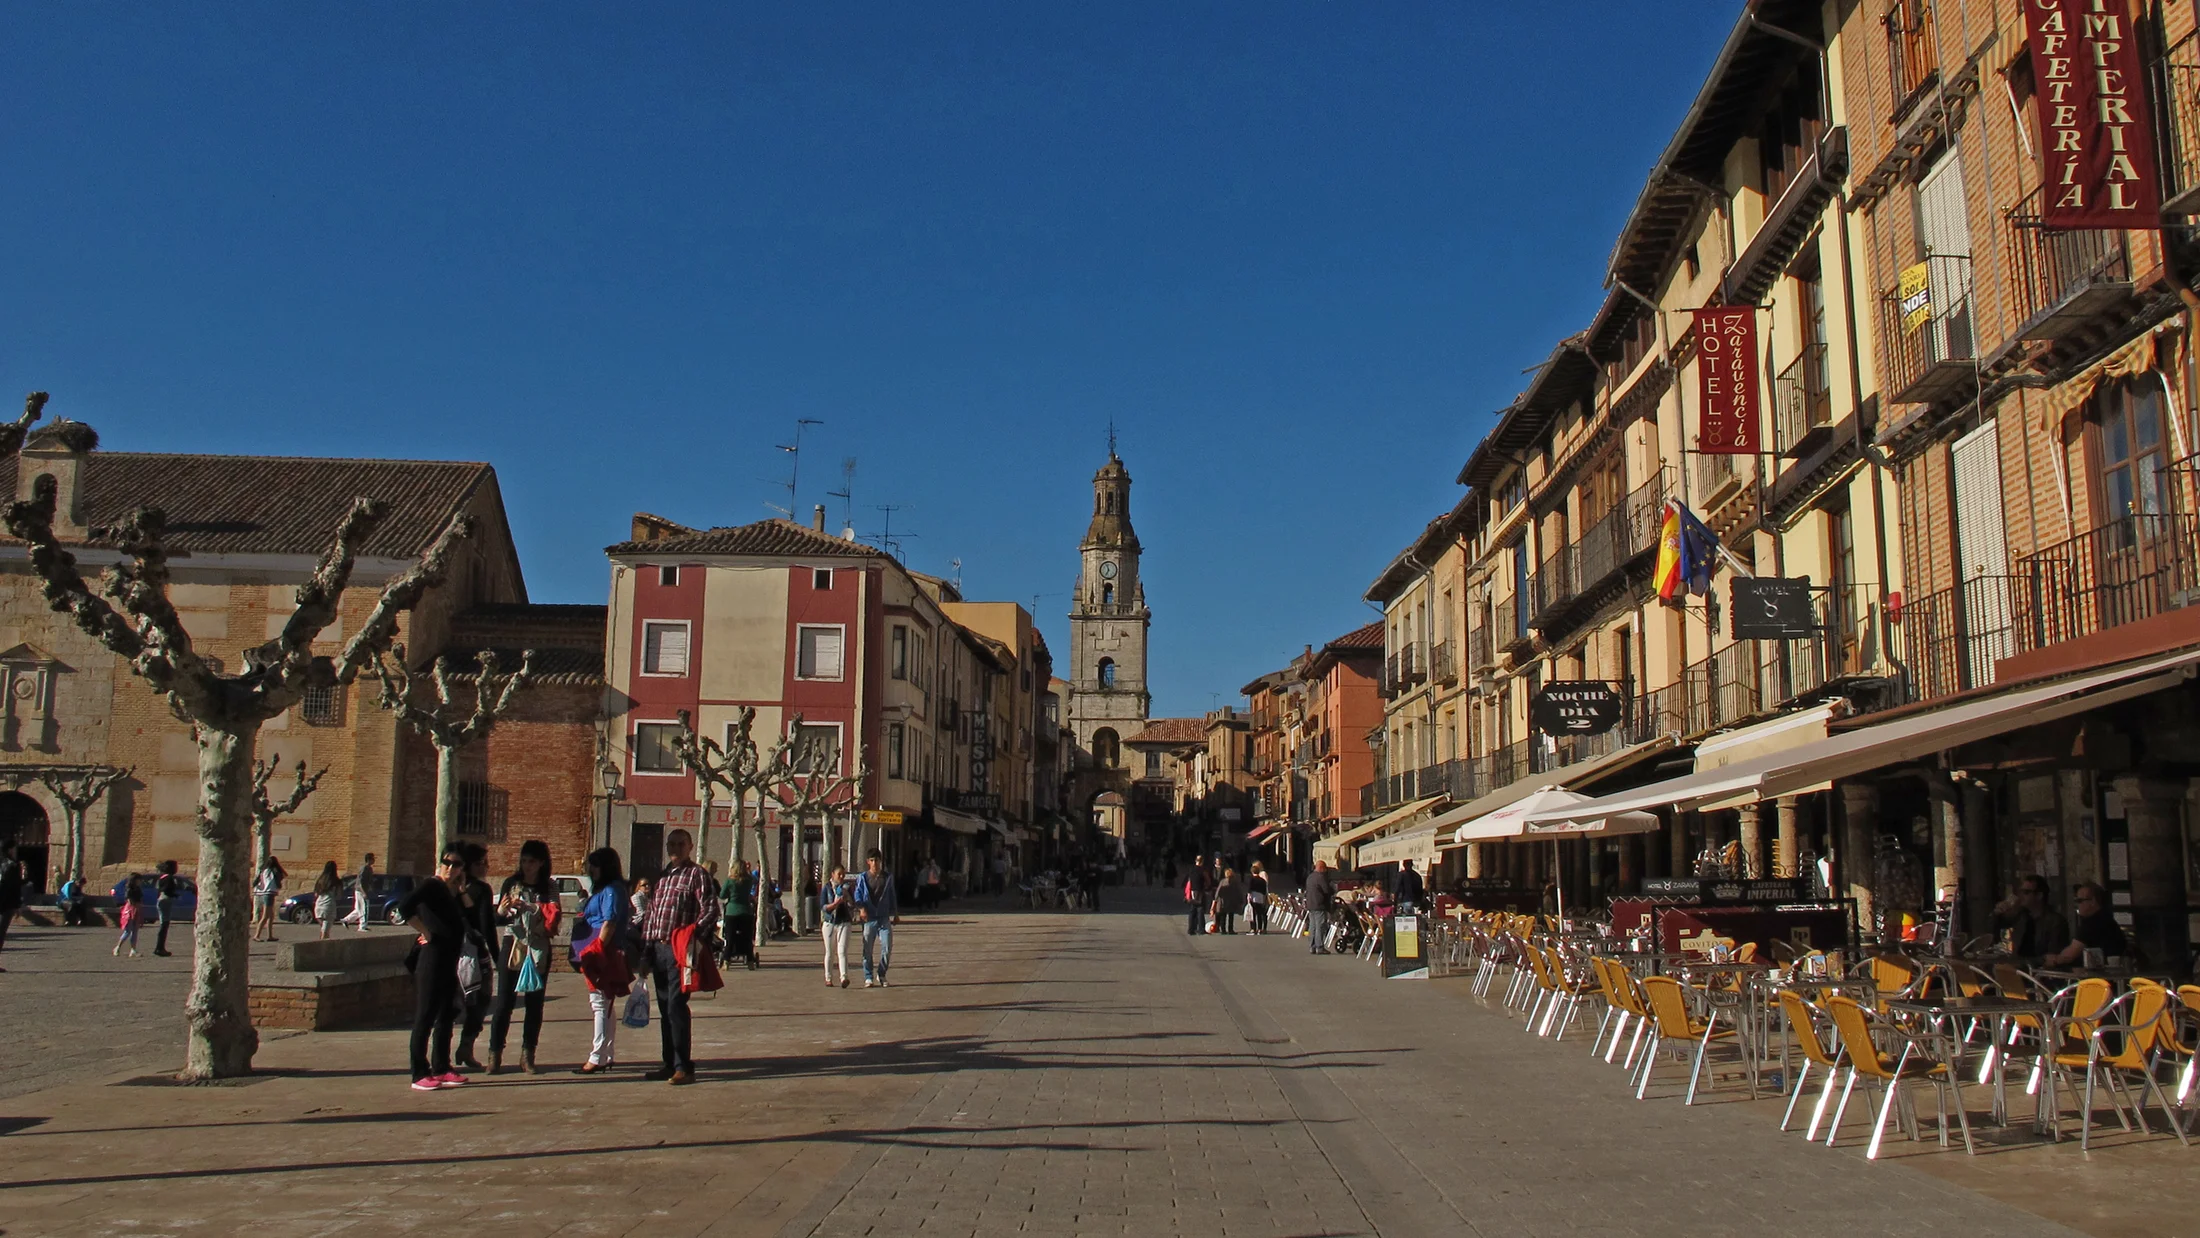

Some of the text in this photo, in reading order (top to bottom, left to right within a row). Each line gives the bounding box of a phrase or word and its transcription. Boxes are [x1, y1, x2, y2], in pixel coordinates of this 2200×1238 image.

[1702, 317, 1721, 416] HOTEL
[1723, 313, 1748, 447] Zaravencia
[1546, 691, 1609, 702] NOCHE
[1566, 719, 1592, 729] 2
[972, 713, 986, 793] MESON
[958, 796, 999, 809] ZAMORA
[1747, 888, 1797, 900] IMPERIAL
